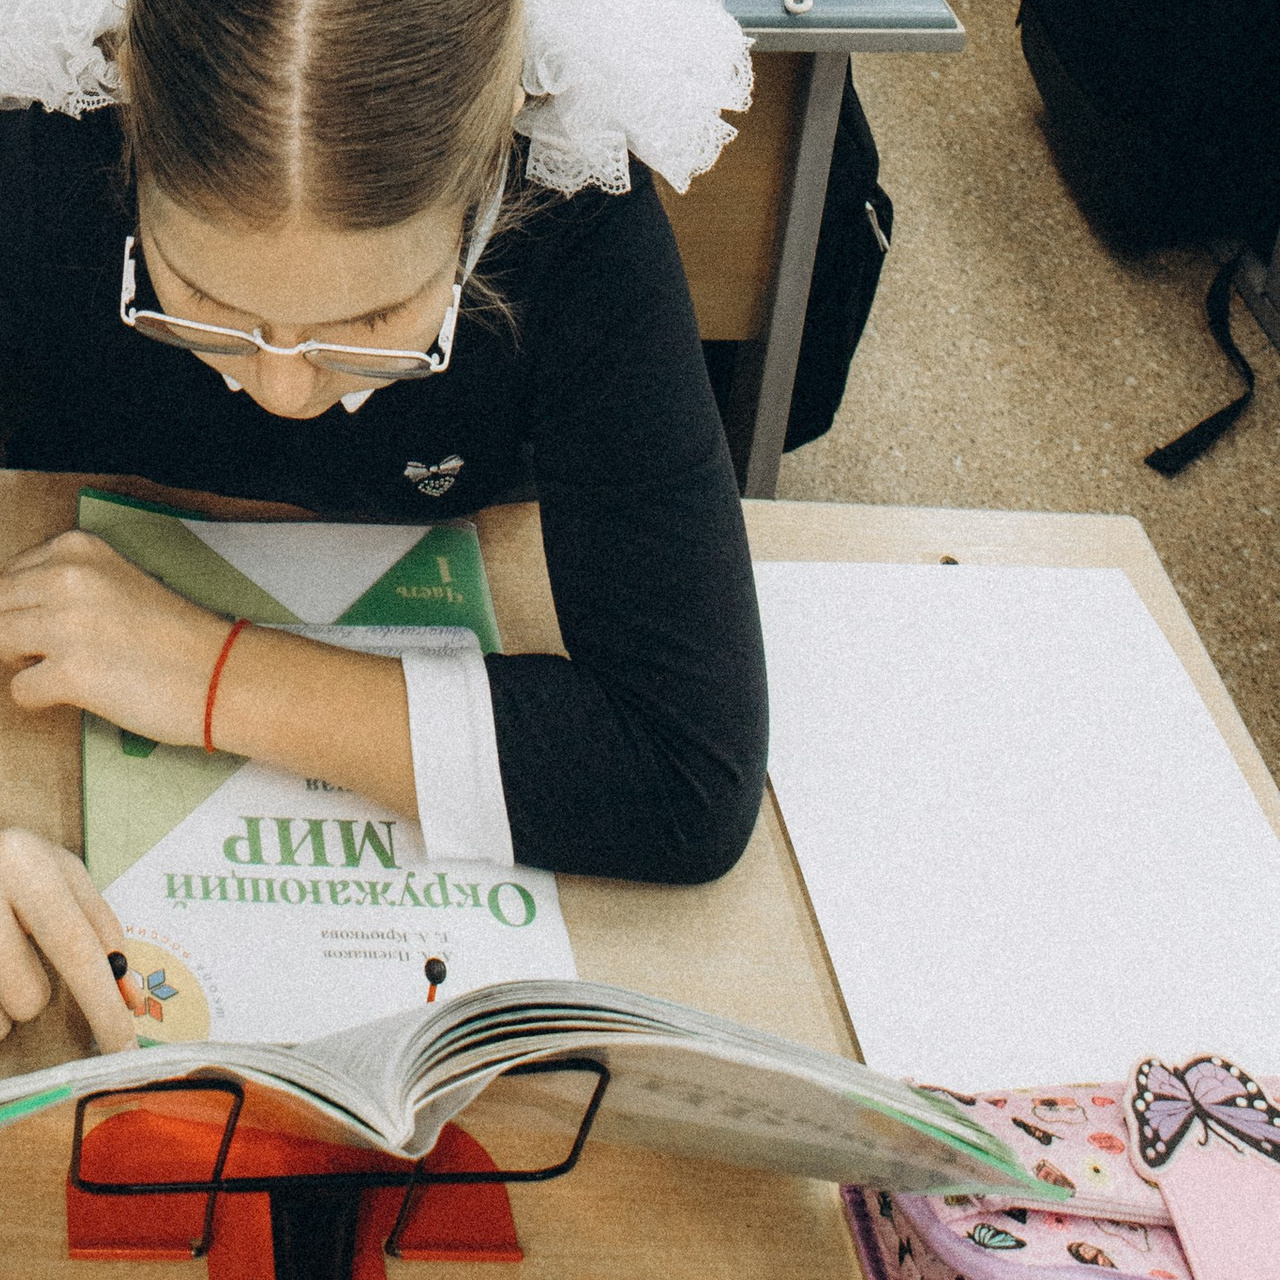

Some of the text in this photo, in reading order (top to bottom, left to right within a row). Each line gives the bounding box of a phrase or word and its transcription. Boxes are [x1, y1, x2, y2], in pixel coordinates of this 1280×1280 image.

[435, 556, 453, 582] 1
[395, 585, 464, 603] Часть
[222, 816, 401, 870] МИР
[163, 870, 536, 928] Окружающий
[126, 926, 191, 959] РОССИИ
[320, 928, 407, 942] Крючкова
[323, 950, 410, 962] Плешаков
